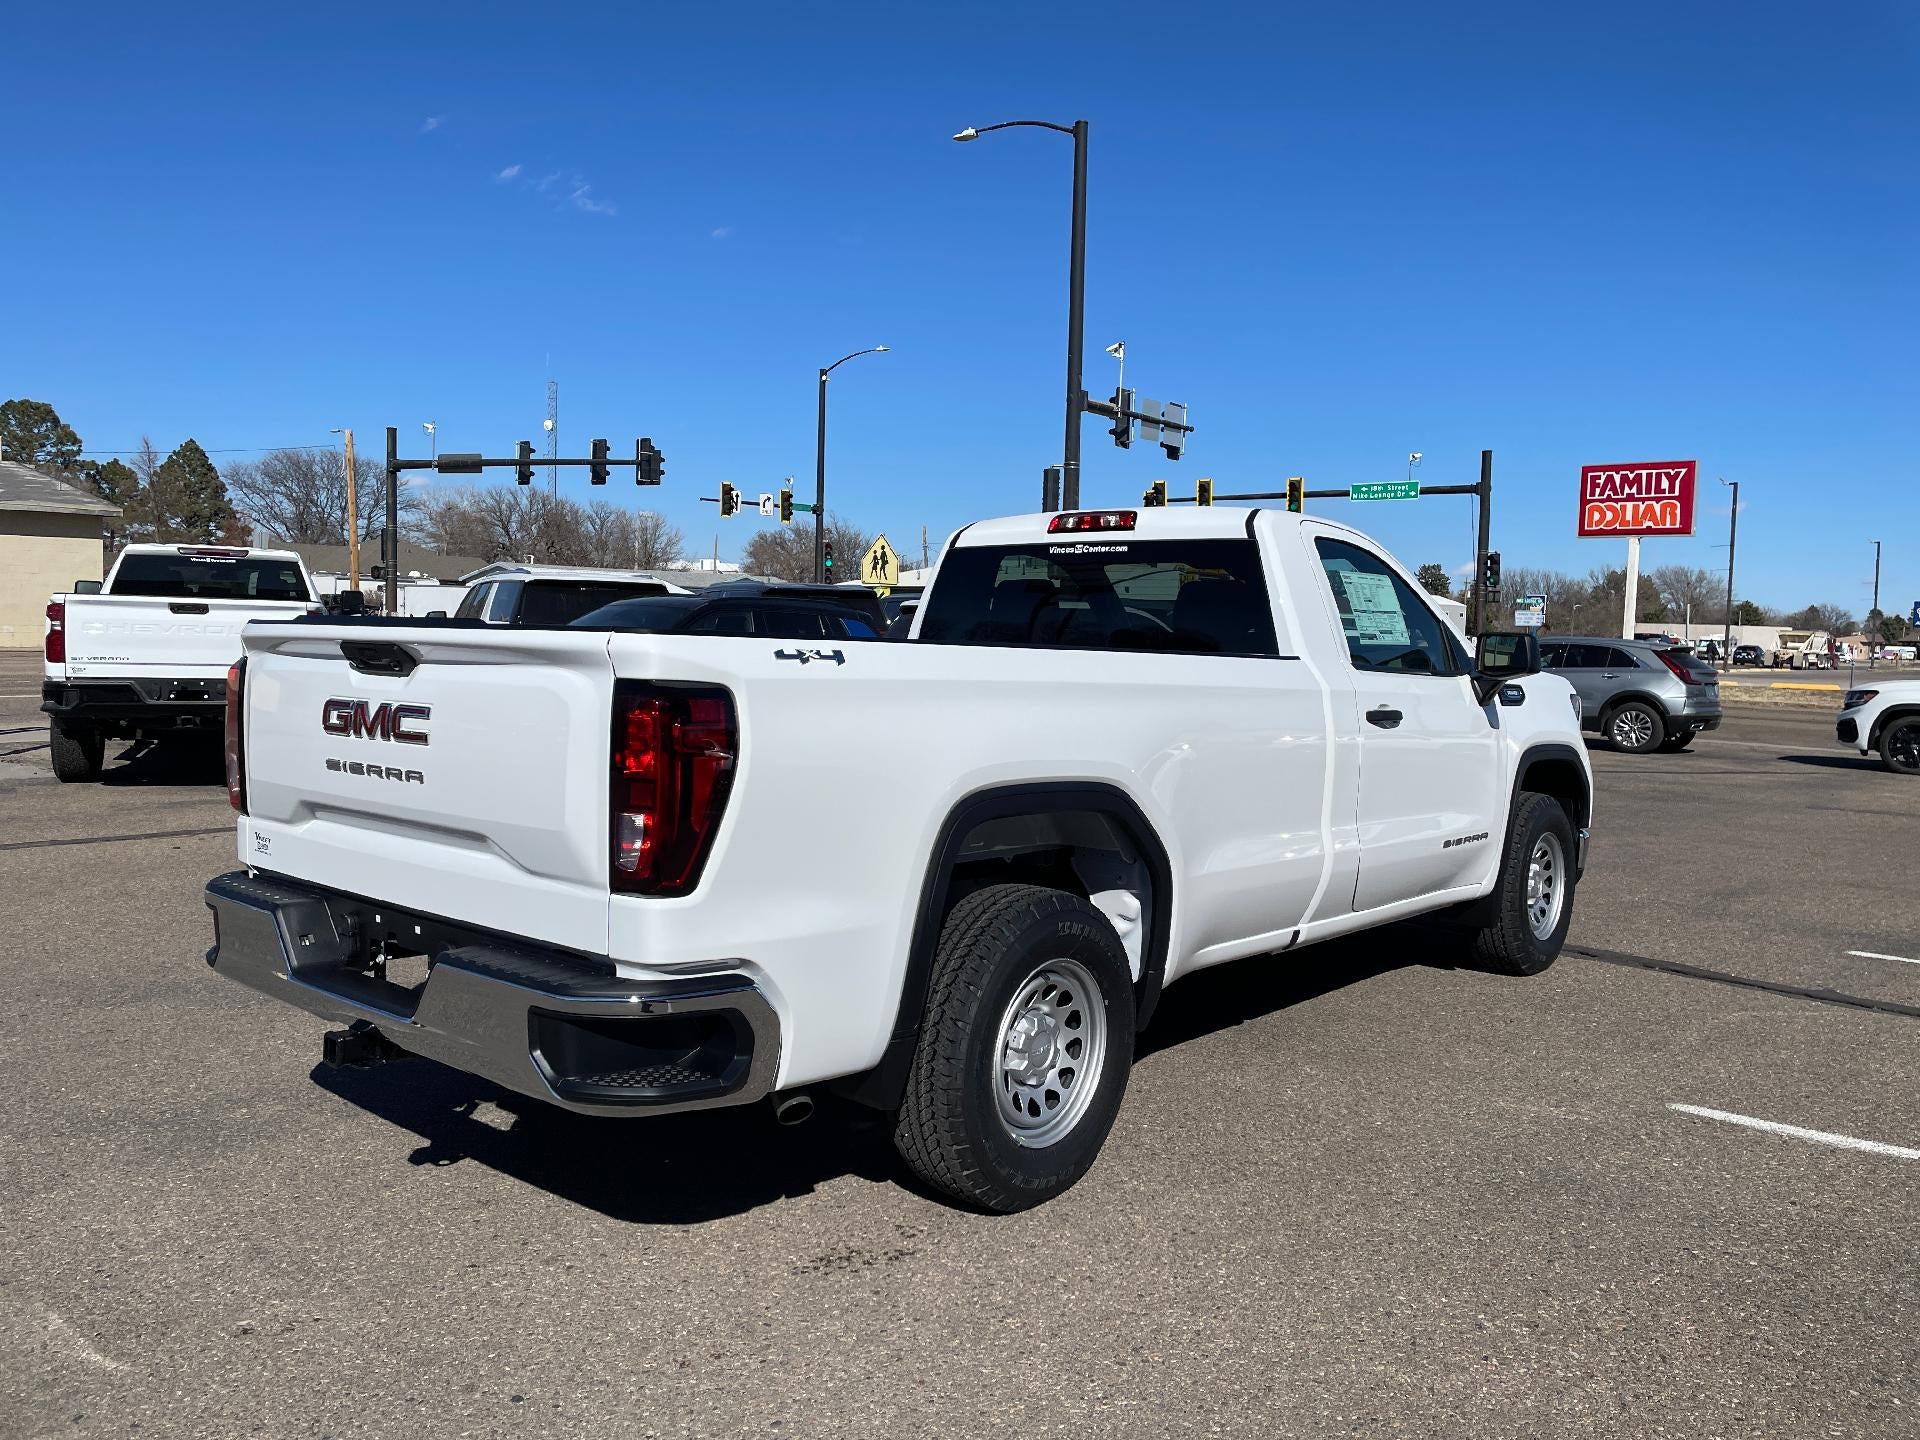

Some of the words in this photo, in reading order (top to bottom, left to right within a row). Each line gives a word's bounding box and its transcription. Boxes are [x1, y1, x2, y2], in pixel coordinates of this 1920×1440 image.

[1587, 468, 1688, 499] FAMILY
[1584, 500, 1681, 530] DOLLAR
[322, 696, 432, 747] GMC
[325, 757, 425, 785] SIERRA
[1442, 831, 1489, 849] SIERRA
